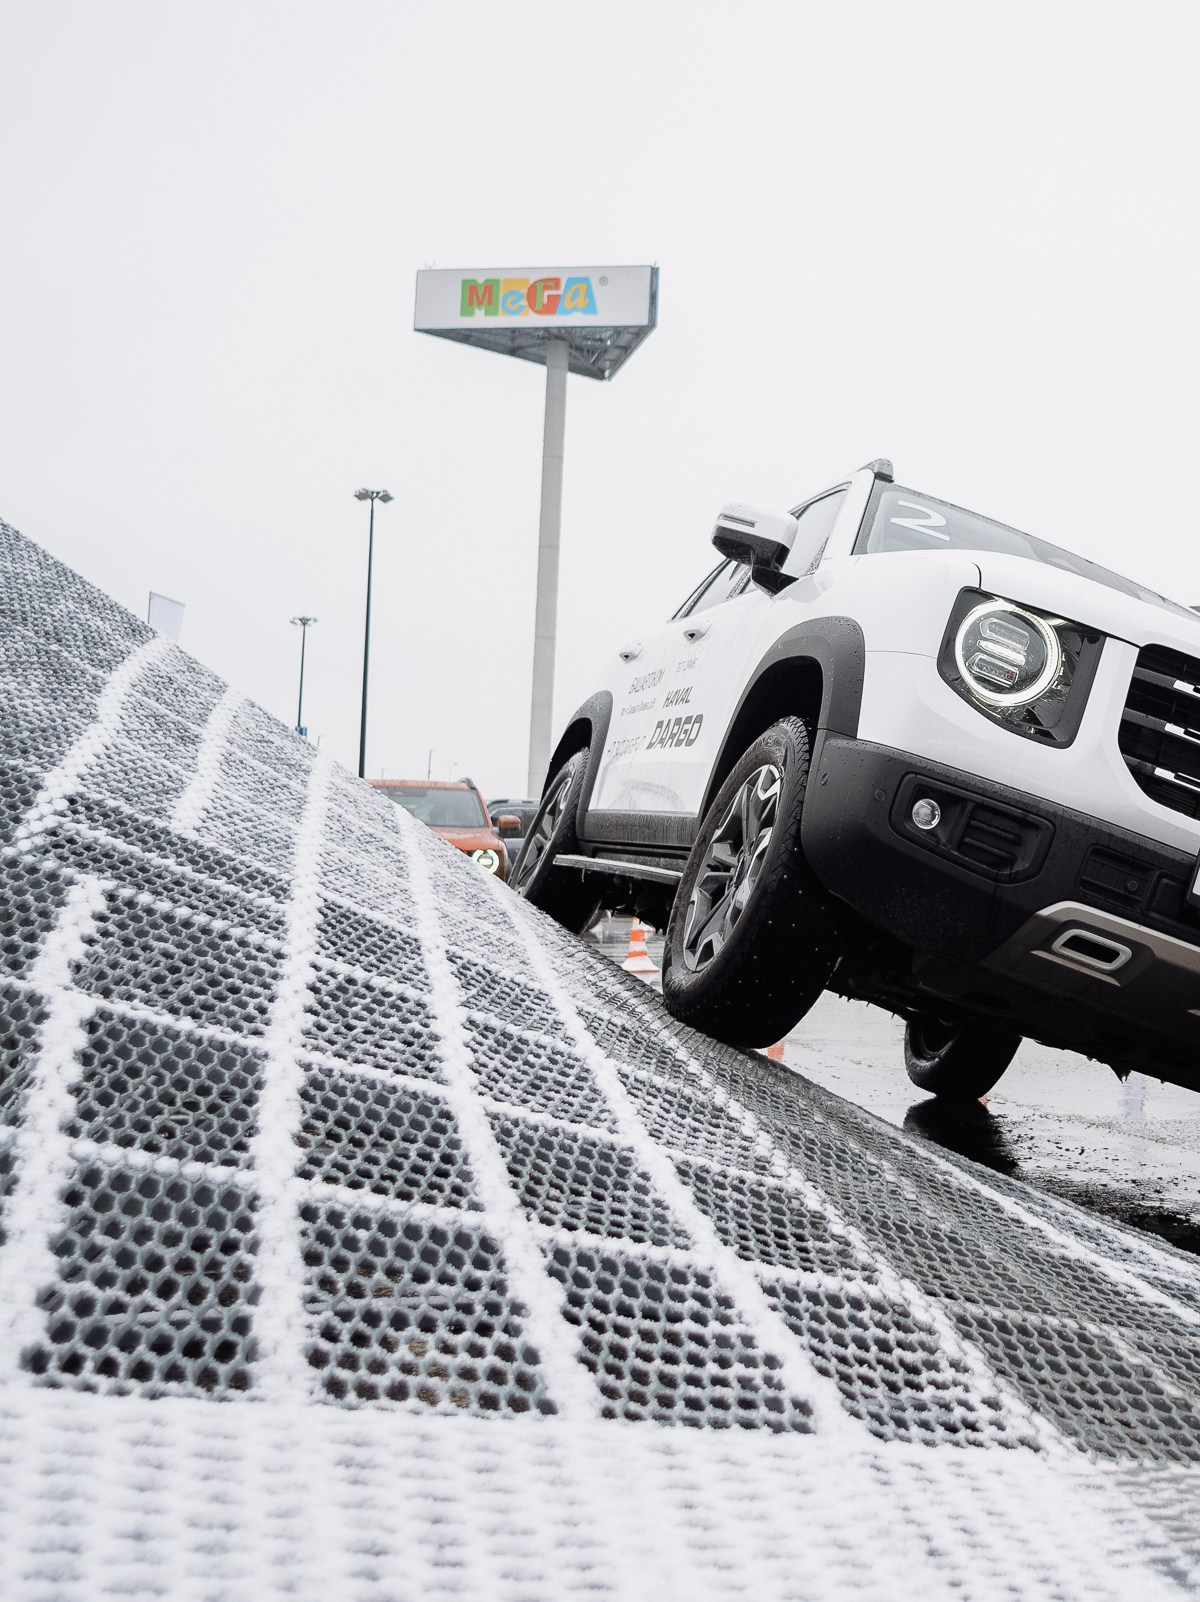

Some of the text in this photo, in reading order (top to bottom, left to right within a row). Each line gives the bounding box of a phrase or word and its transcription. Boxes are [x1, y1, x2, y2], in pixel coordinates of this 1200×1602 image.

[890, 500, 950, 541] 2
[662, 686, 693, 708] HAVAL
[645, 714, 704, 750] DARGO
